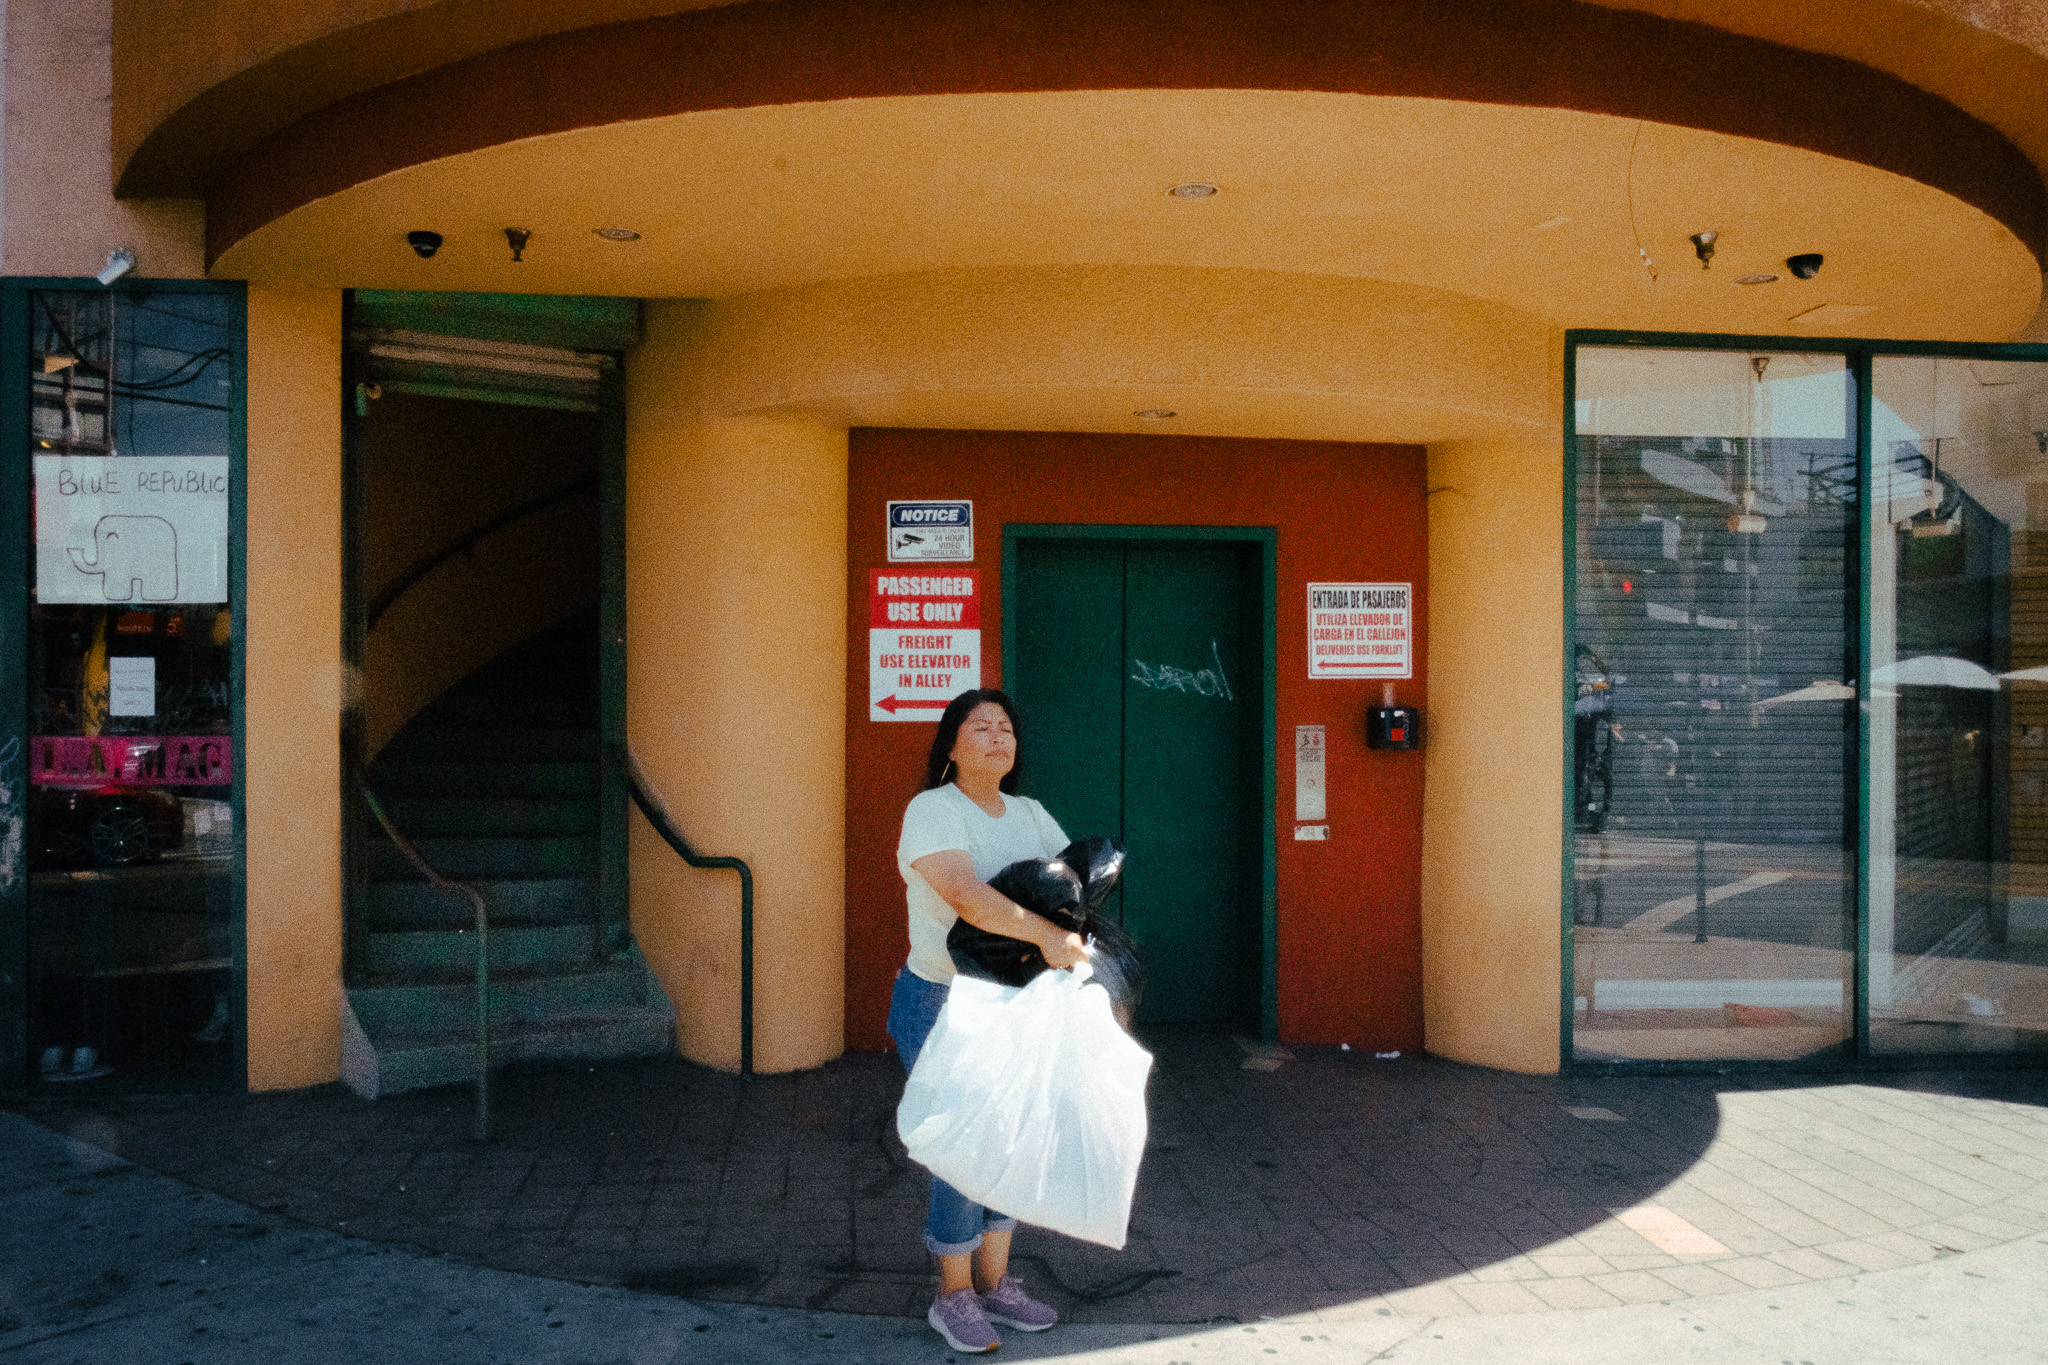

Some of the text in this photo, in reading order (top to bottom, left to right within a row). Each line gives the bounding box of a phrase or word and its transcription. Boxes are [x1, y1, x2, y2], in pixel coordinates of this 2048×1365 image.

[900, 509, 959, 522] NOTICE
[877, 576, 973, 596] PASSENGER
[1313, 590, 1407, 609] ENTRADA DE PASAJEROS
[888, 602, 963, 622] USE ONLY
[1316, 613, 1403, 626] UTILIZA ELEVADOR DE
[1314, 628, 1406, 641] CARGA EN EL CALLEJON
[898, 635, 952, 649] FREIGHT
[1316, 645, 1403, 656] DELIVERIES USE FORKLIFT
[880, 654, 971, 669] USE ELEVATOR
[898, 674, 952, 688] IN ALLEY
